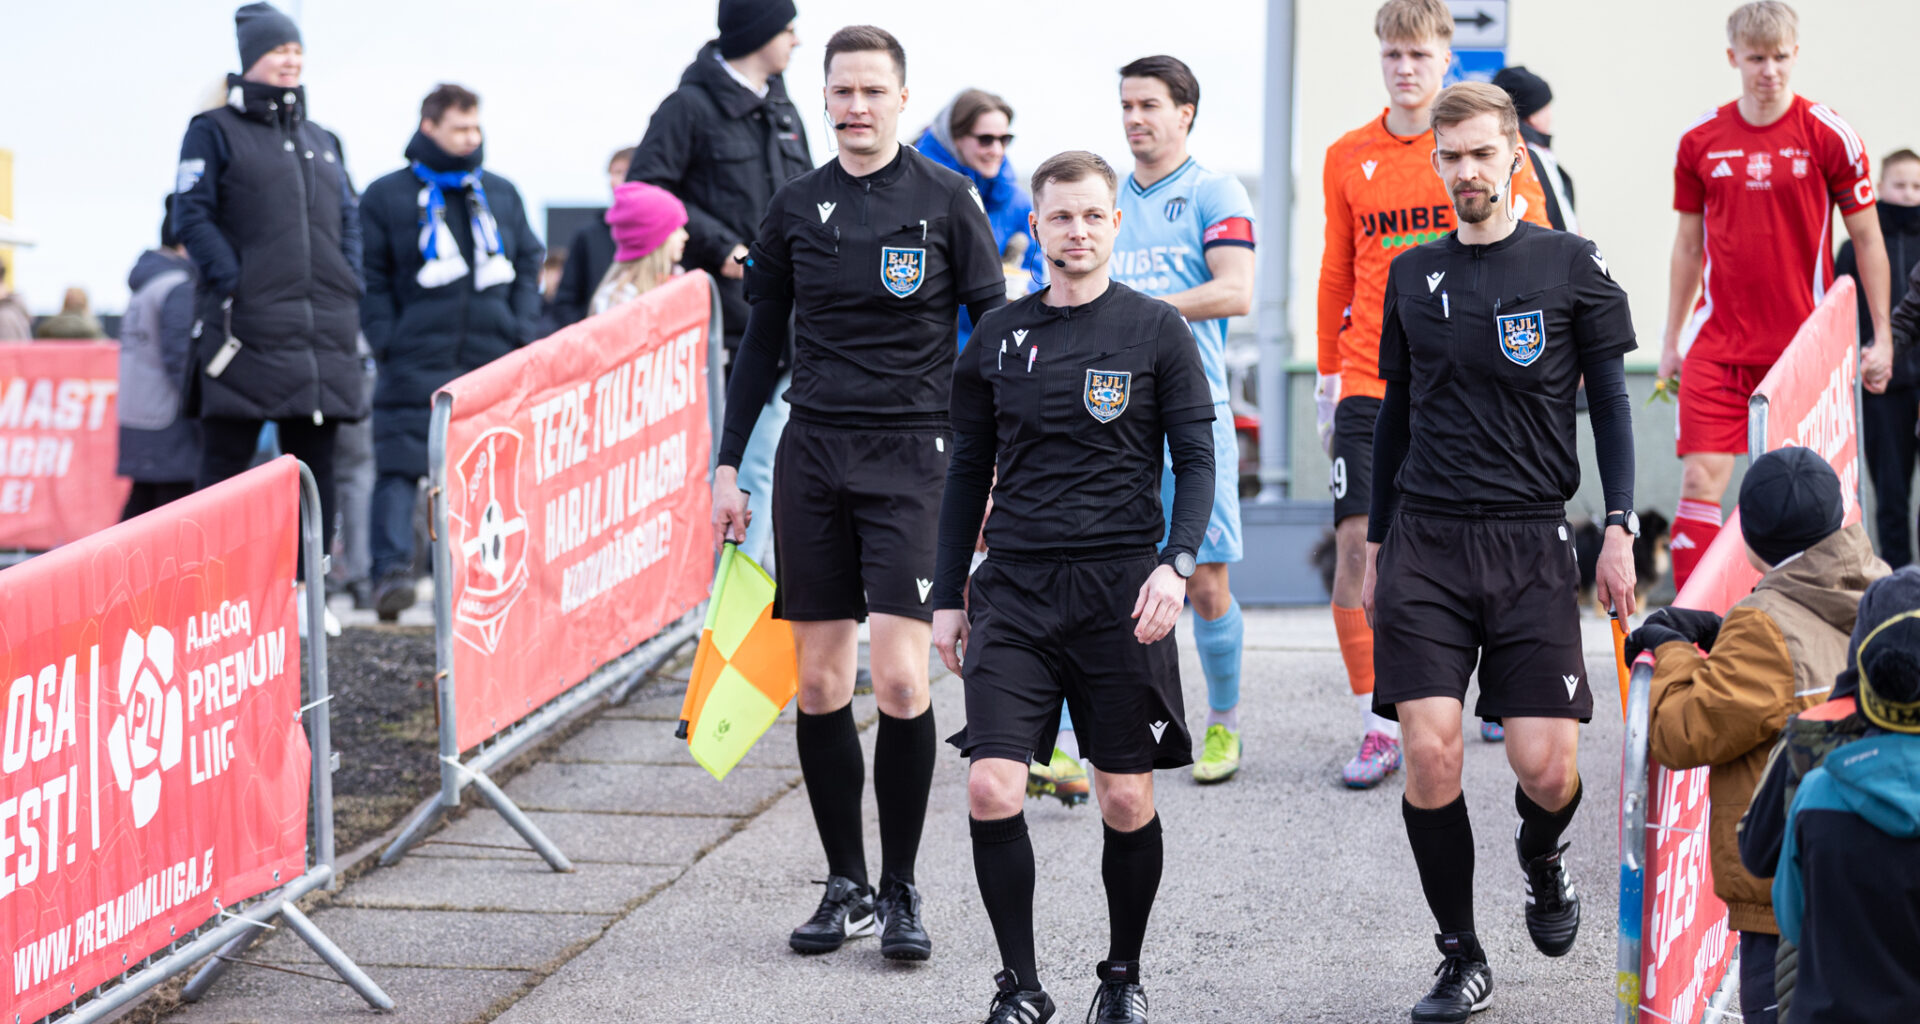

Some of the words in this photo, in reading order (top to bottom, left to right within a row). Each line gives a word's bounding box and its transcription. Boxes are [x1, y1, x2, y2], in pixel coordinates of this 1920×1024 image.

[1854, 178, 1873, 204] C
[1360, 205, 1456, 237] UNIBE
[888, 252, 918, 265] EJL
[1109, 245, 1190, 275] NIBET
[1503, 317, 1537, 333] EJL
[1092, 375, 1124, 389] EJL
[530, 381, 591, 486] TERE
[3, 654, 77, 774] OSA
[189, 717, 238, 786] LIIG
[13, 845, 215, 996] WWW.PREMIUMLIIGA.E
